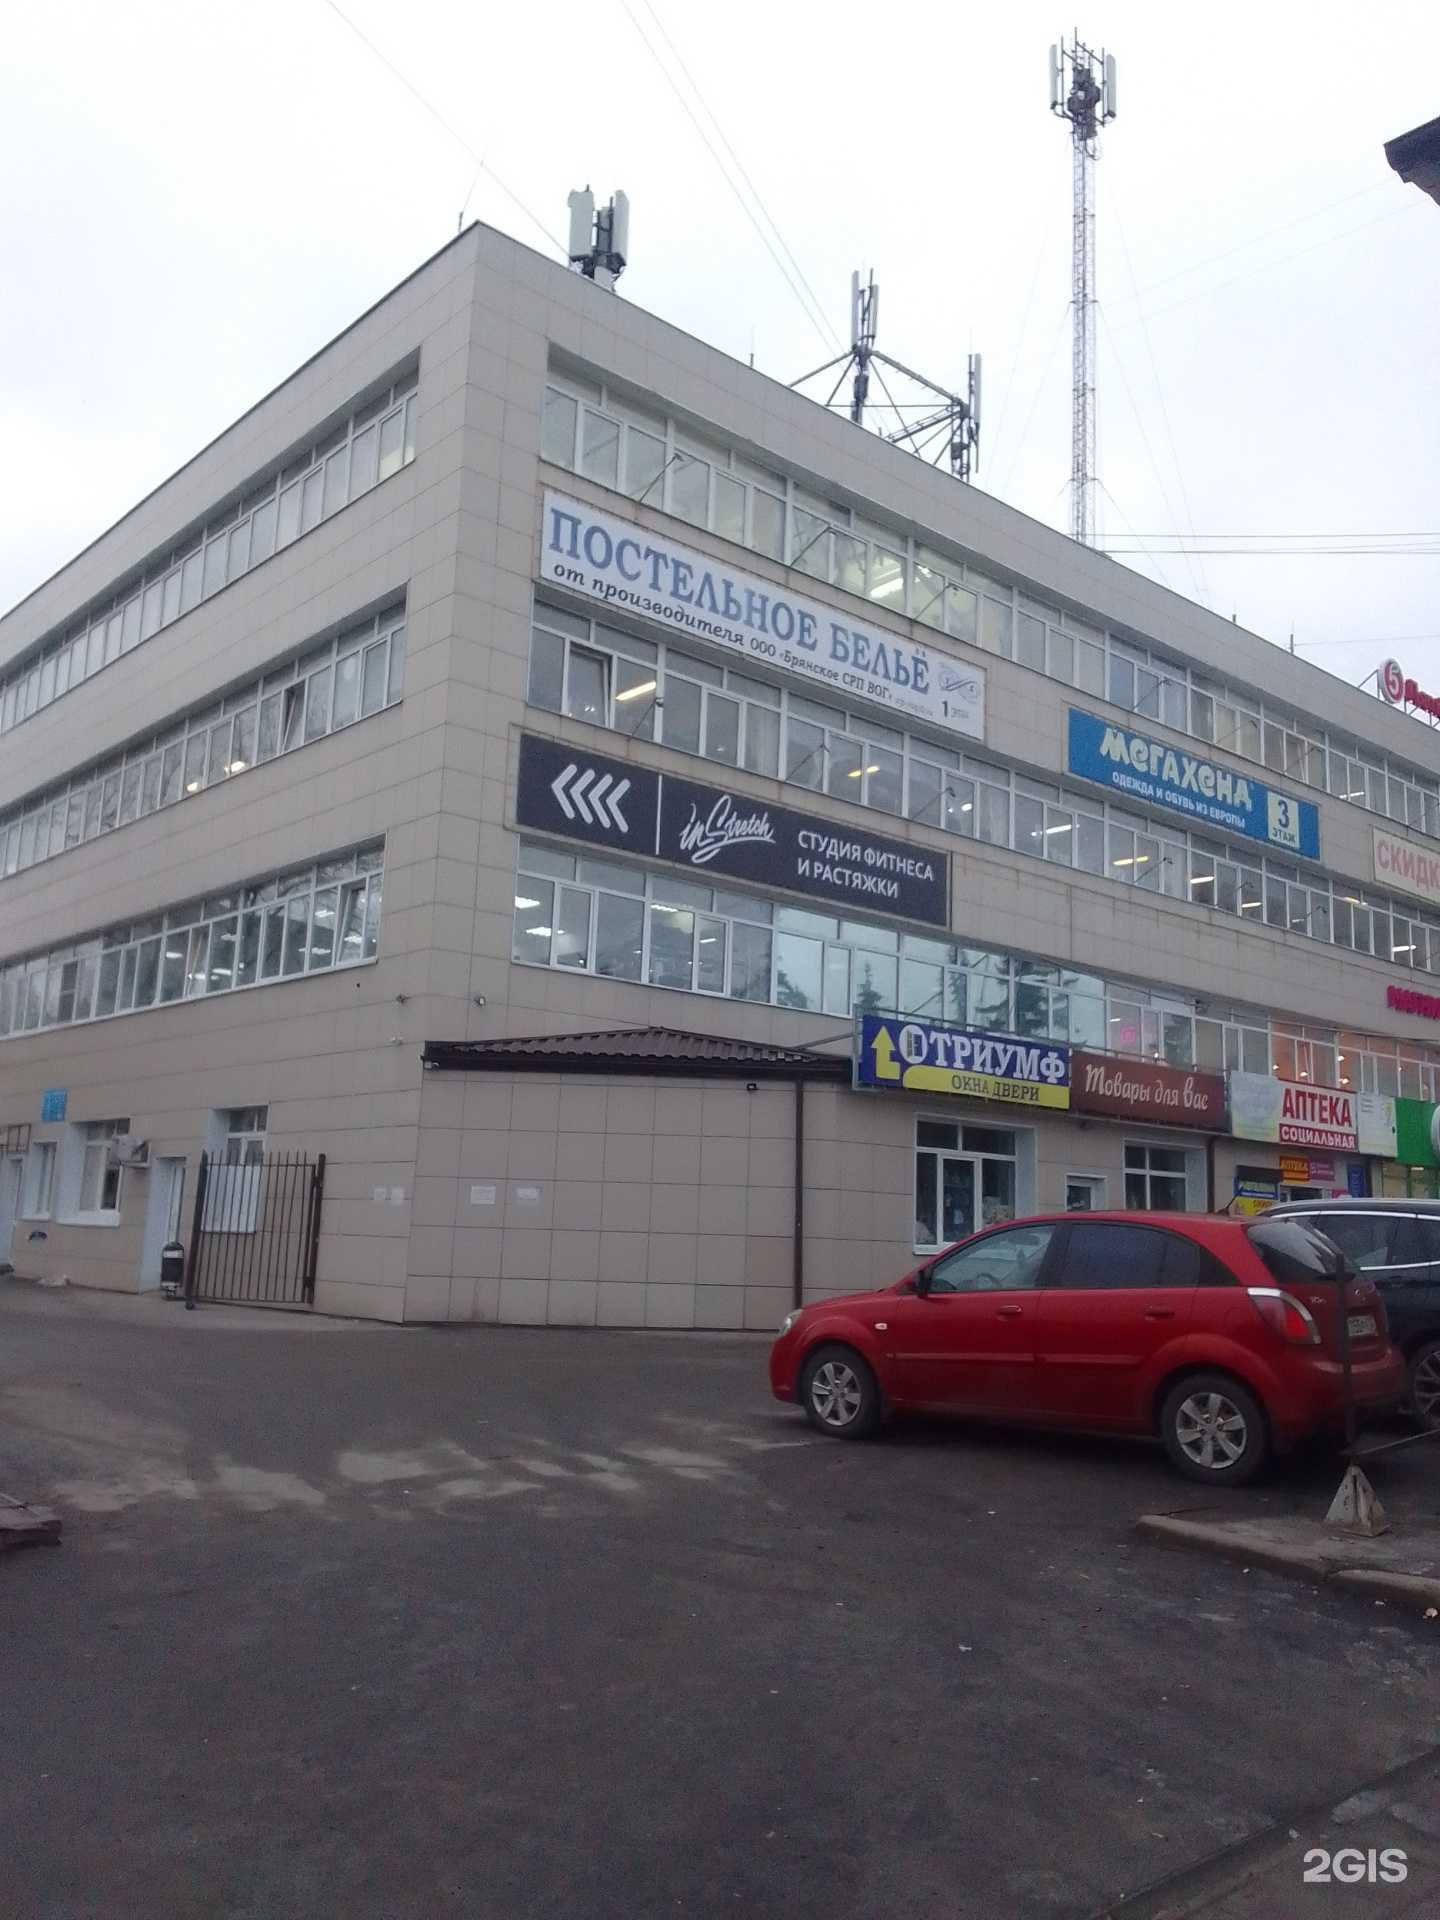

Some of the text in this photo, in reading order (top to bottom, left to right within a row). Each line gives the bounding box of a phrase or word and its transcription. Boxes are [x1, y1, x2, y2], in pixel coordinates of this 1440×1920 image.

[548, 508, 931, 696] ПОСТЕЛЬНОЕ БЕЛЬЁ
[554, 563, 585, 586] от
[592, 577, 745, 647] производителя
[750, 638, 777, 658] ООО
[842, 672, 865, 691] СРП
[941, 700, 949, 718] 1
[1112, 771, 1246, 829] ОДЕЖДА И ОБУВЬ ИЗ ЕВРОПЫ
[1278, 800, 1290, 829] 3
[798, 830, 935, 883] СТУДИЯ ФИТНЕСА
[798, 857, 899, 899] И РАСТЯЖКИ
[951, 1074, 1040, 1101] ОКНА ДВЕРИ
[1085, 1063, 1151, 1105] Товары
[1154, 1079, 1179, 1106] для
[1282, 1087, 1353, 1128] АПТЕКА
[1281, 1126, 1355, 1150] СОЦИАЛЬНАЯ
